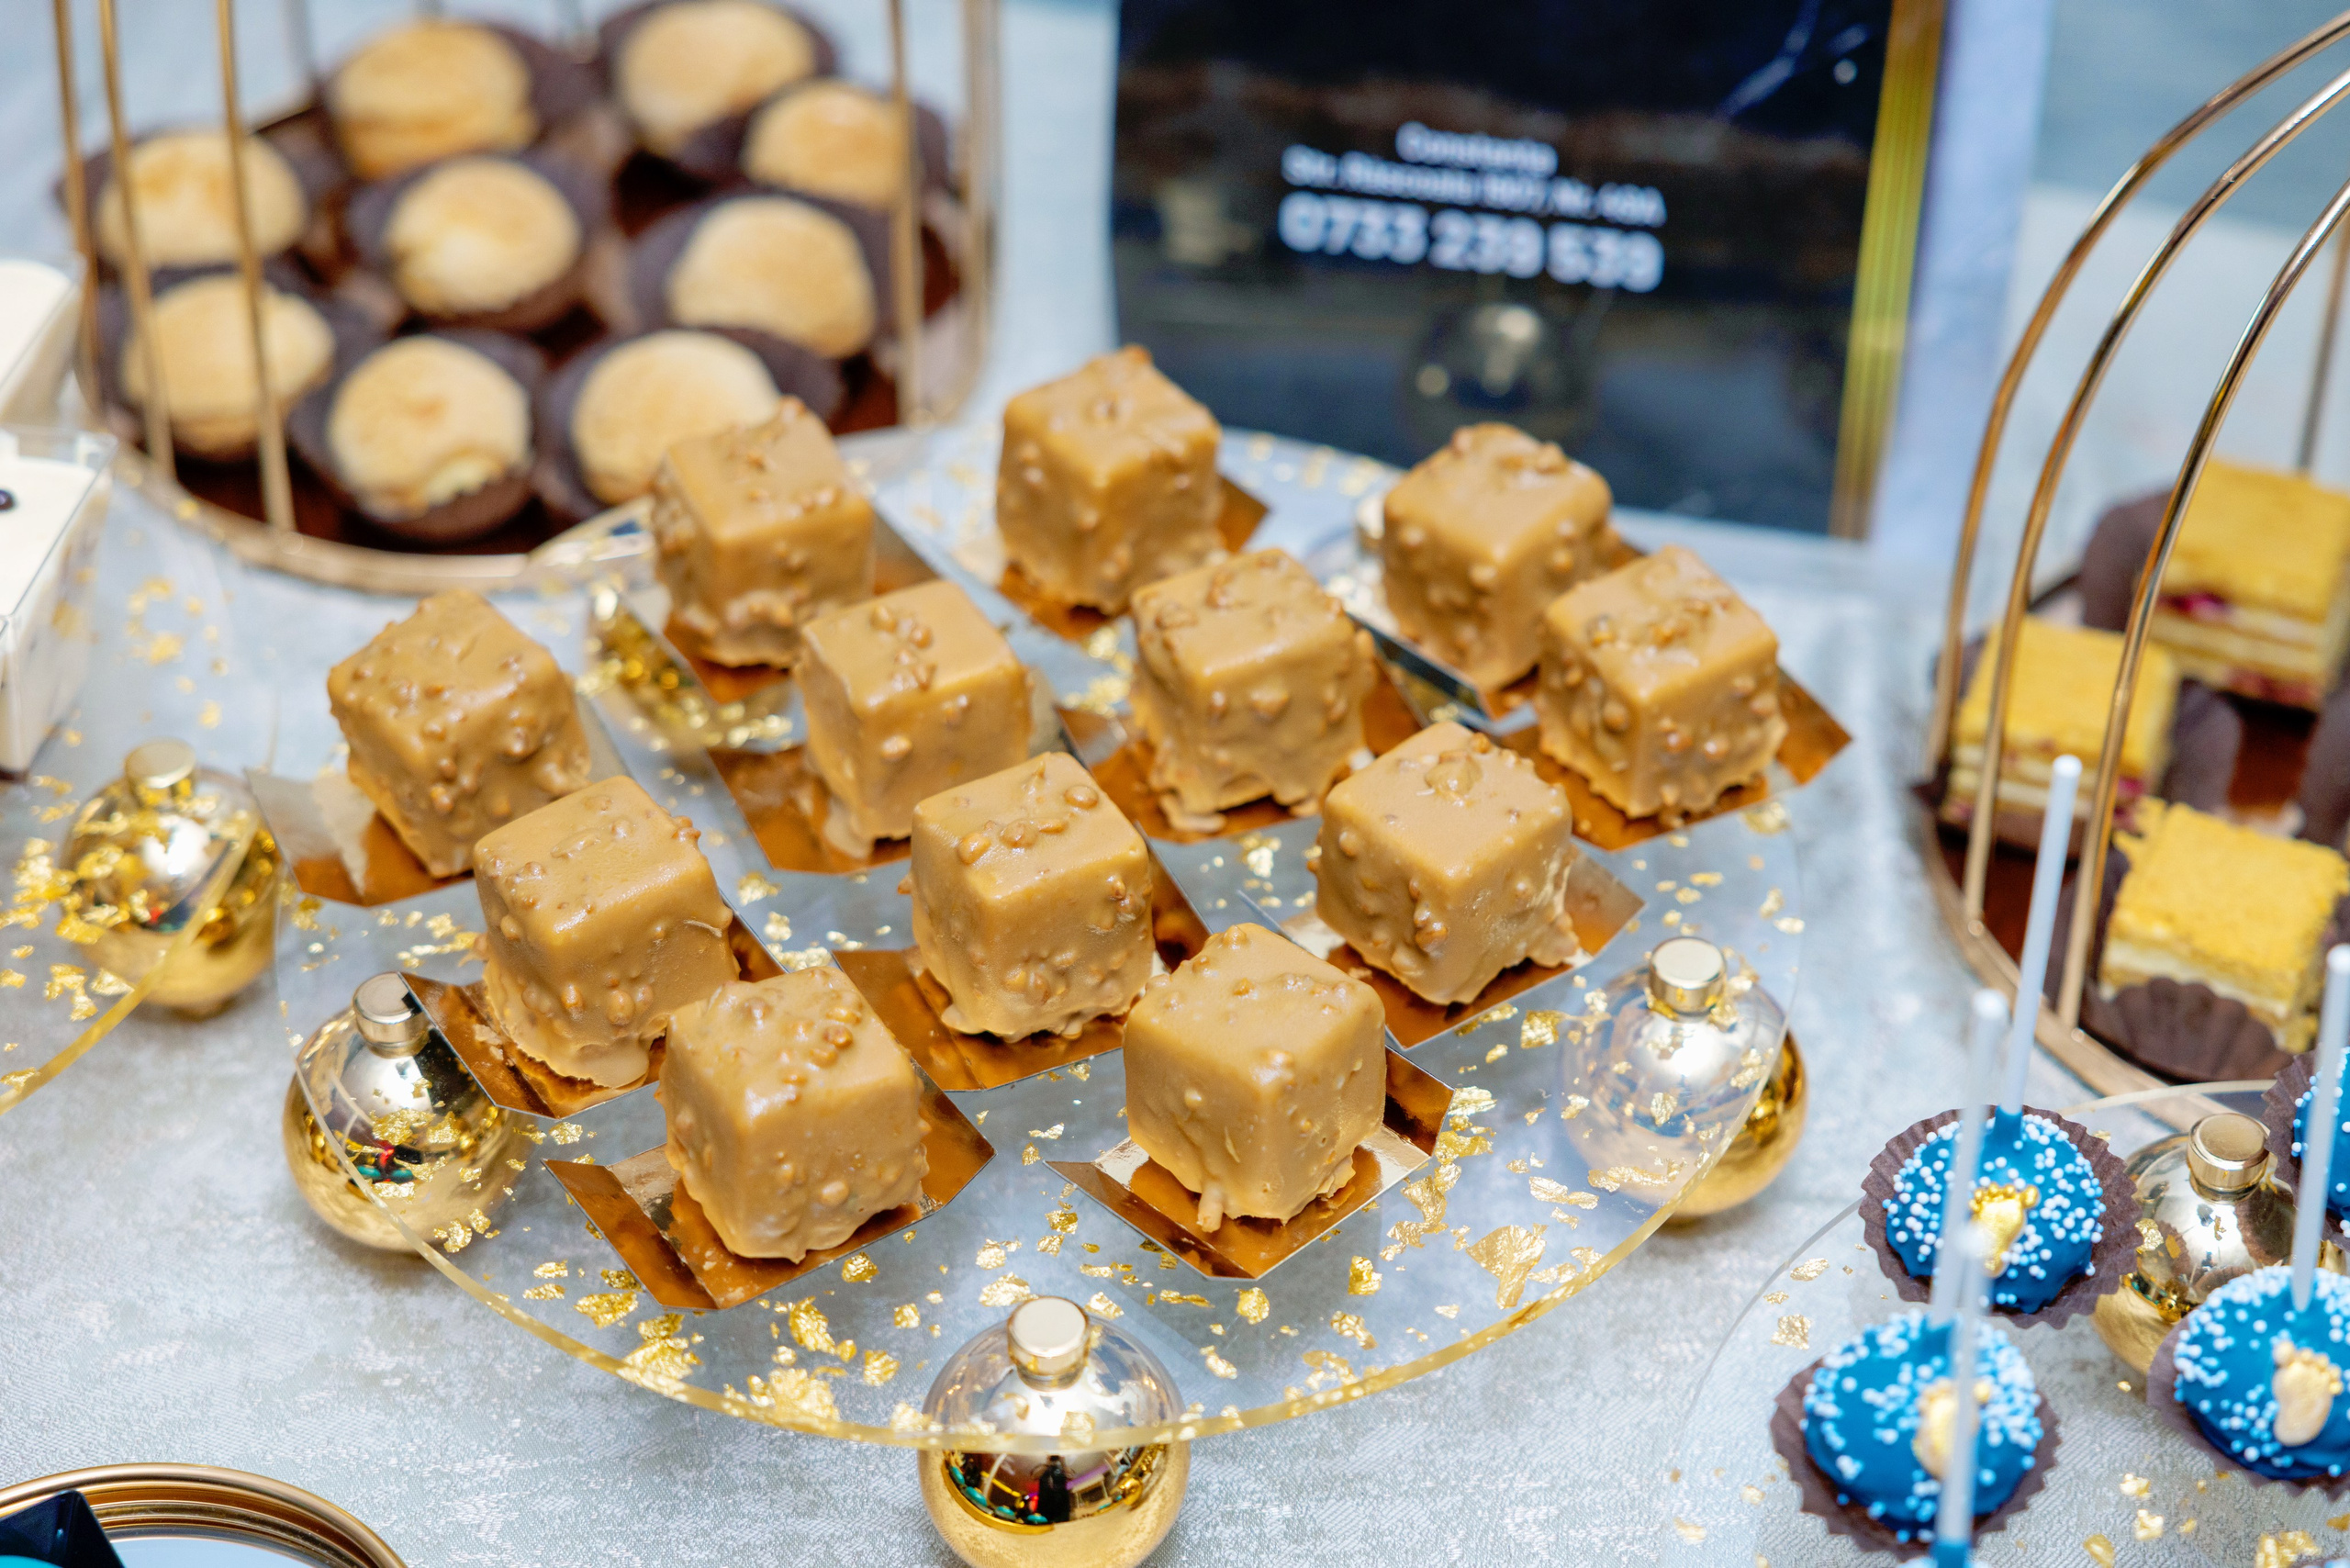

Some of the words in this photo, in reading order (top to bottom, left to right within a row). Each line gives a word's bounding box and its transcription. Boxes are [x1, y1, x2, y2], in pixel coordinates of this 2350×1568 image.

[1279, 191, 1429, 263] 0733
[1429, 208, 1545, 278] 239
[1547, 222, 1665, 293] 539
